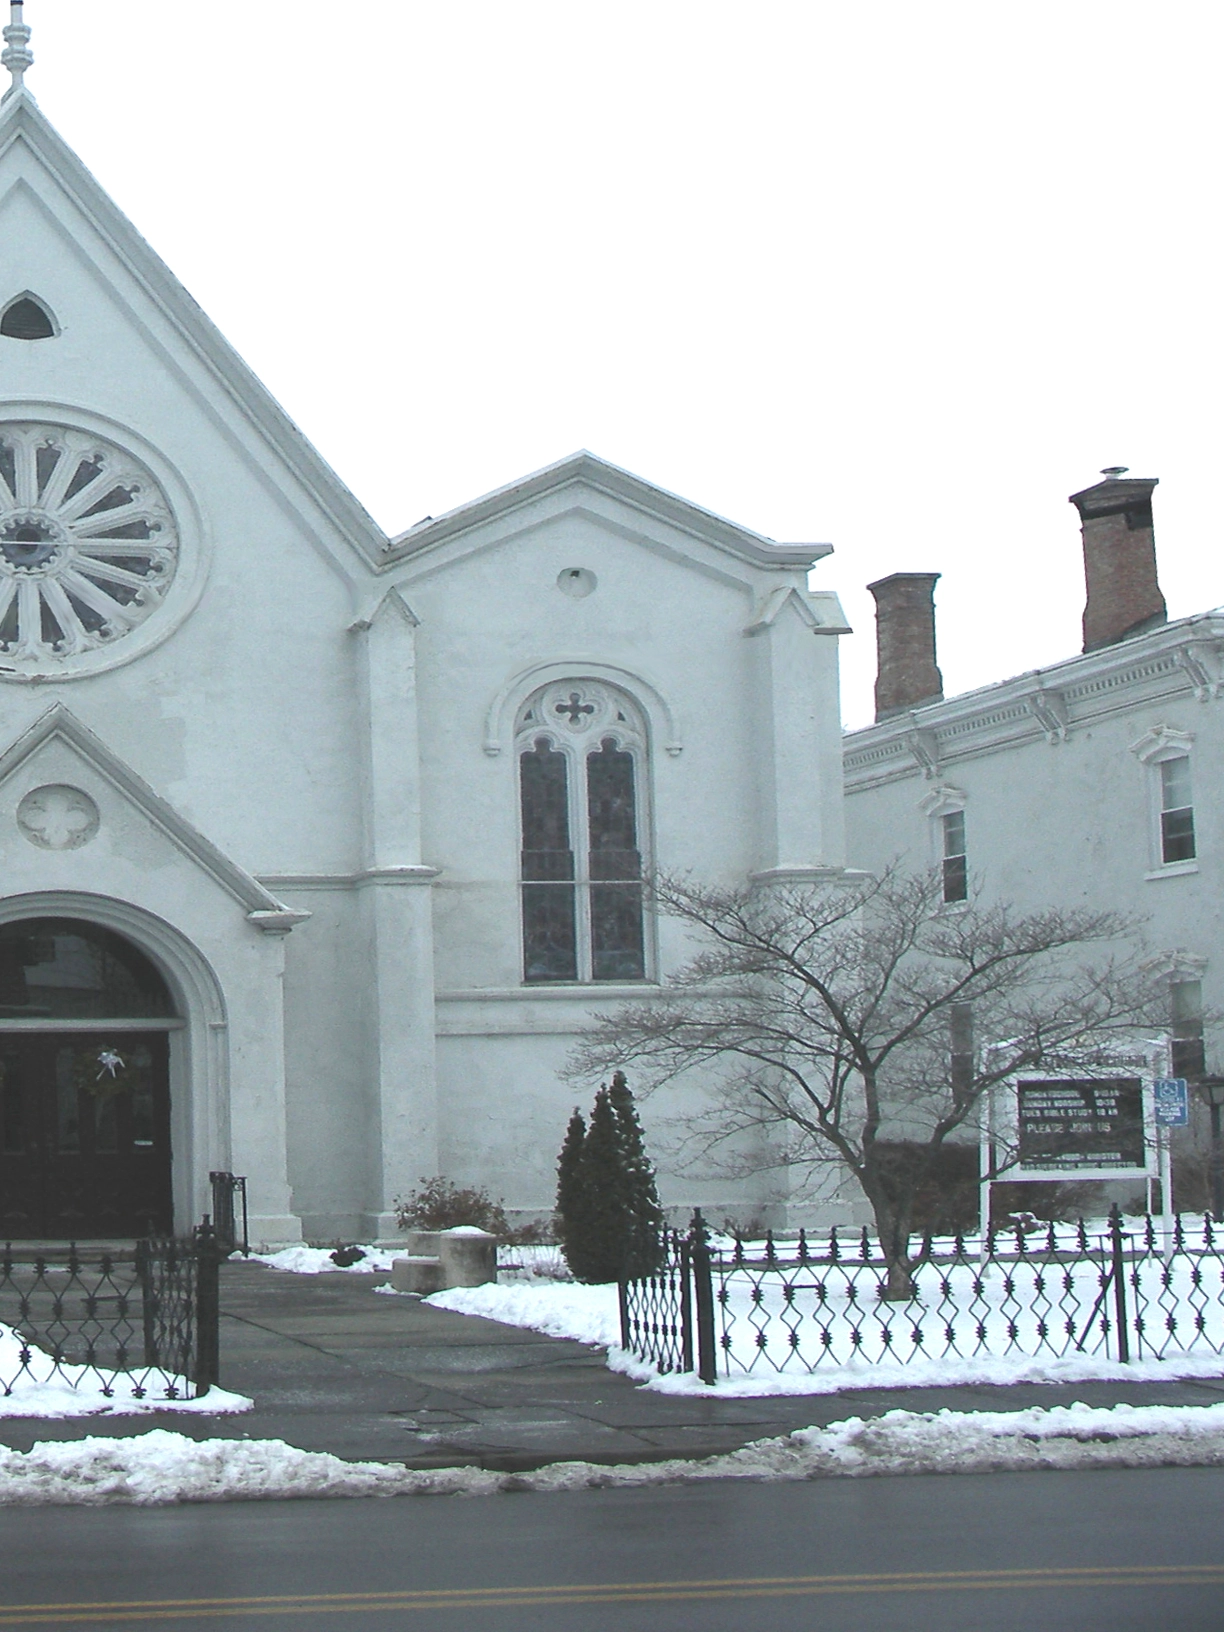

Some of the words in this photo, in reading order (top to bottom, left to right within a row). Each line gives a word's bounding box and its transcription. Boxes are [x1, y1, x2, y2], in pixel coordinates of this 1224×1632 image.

[1067, 1108, 1093, 1117] STUDY
[1026, 1123, 1065, 1134] PLEASE
[1069, 1122, 1092, 1133] JOIN
[1097, 1121, 1112, 1133] US
